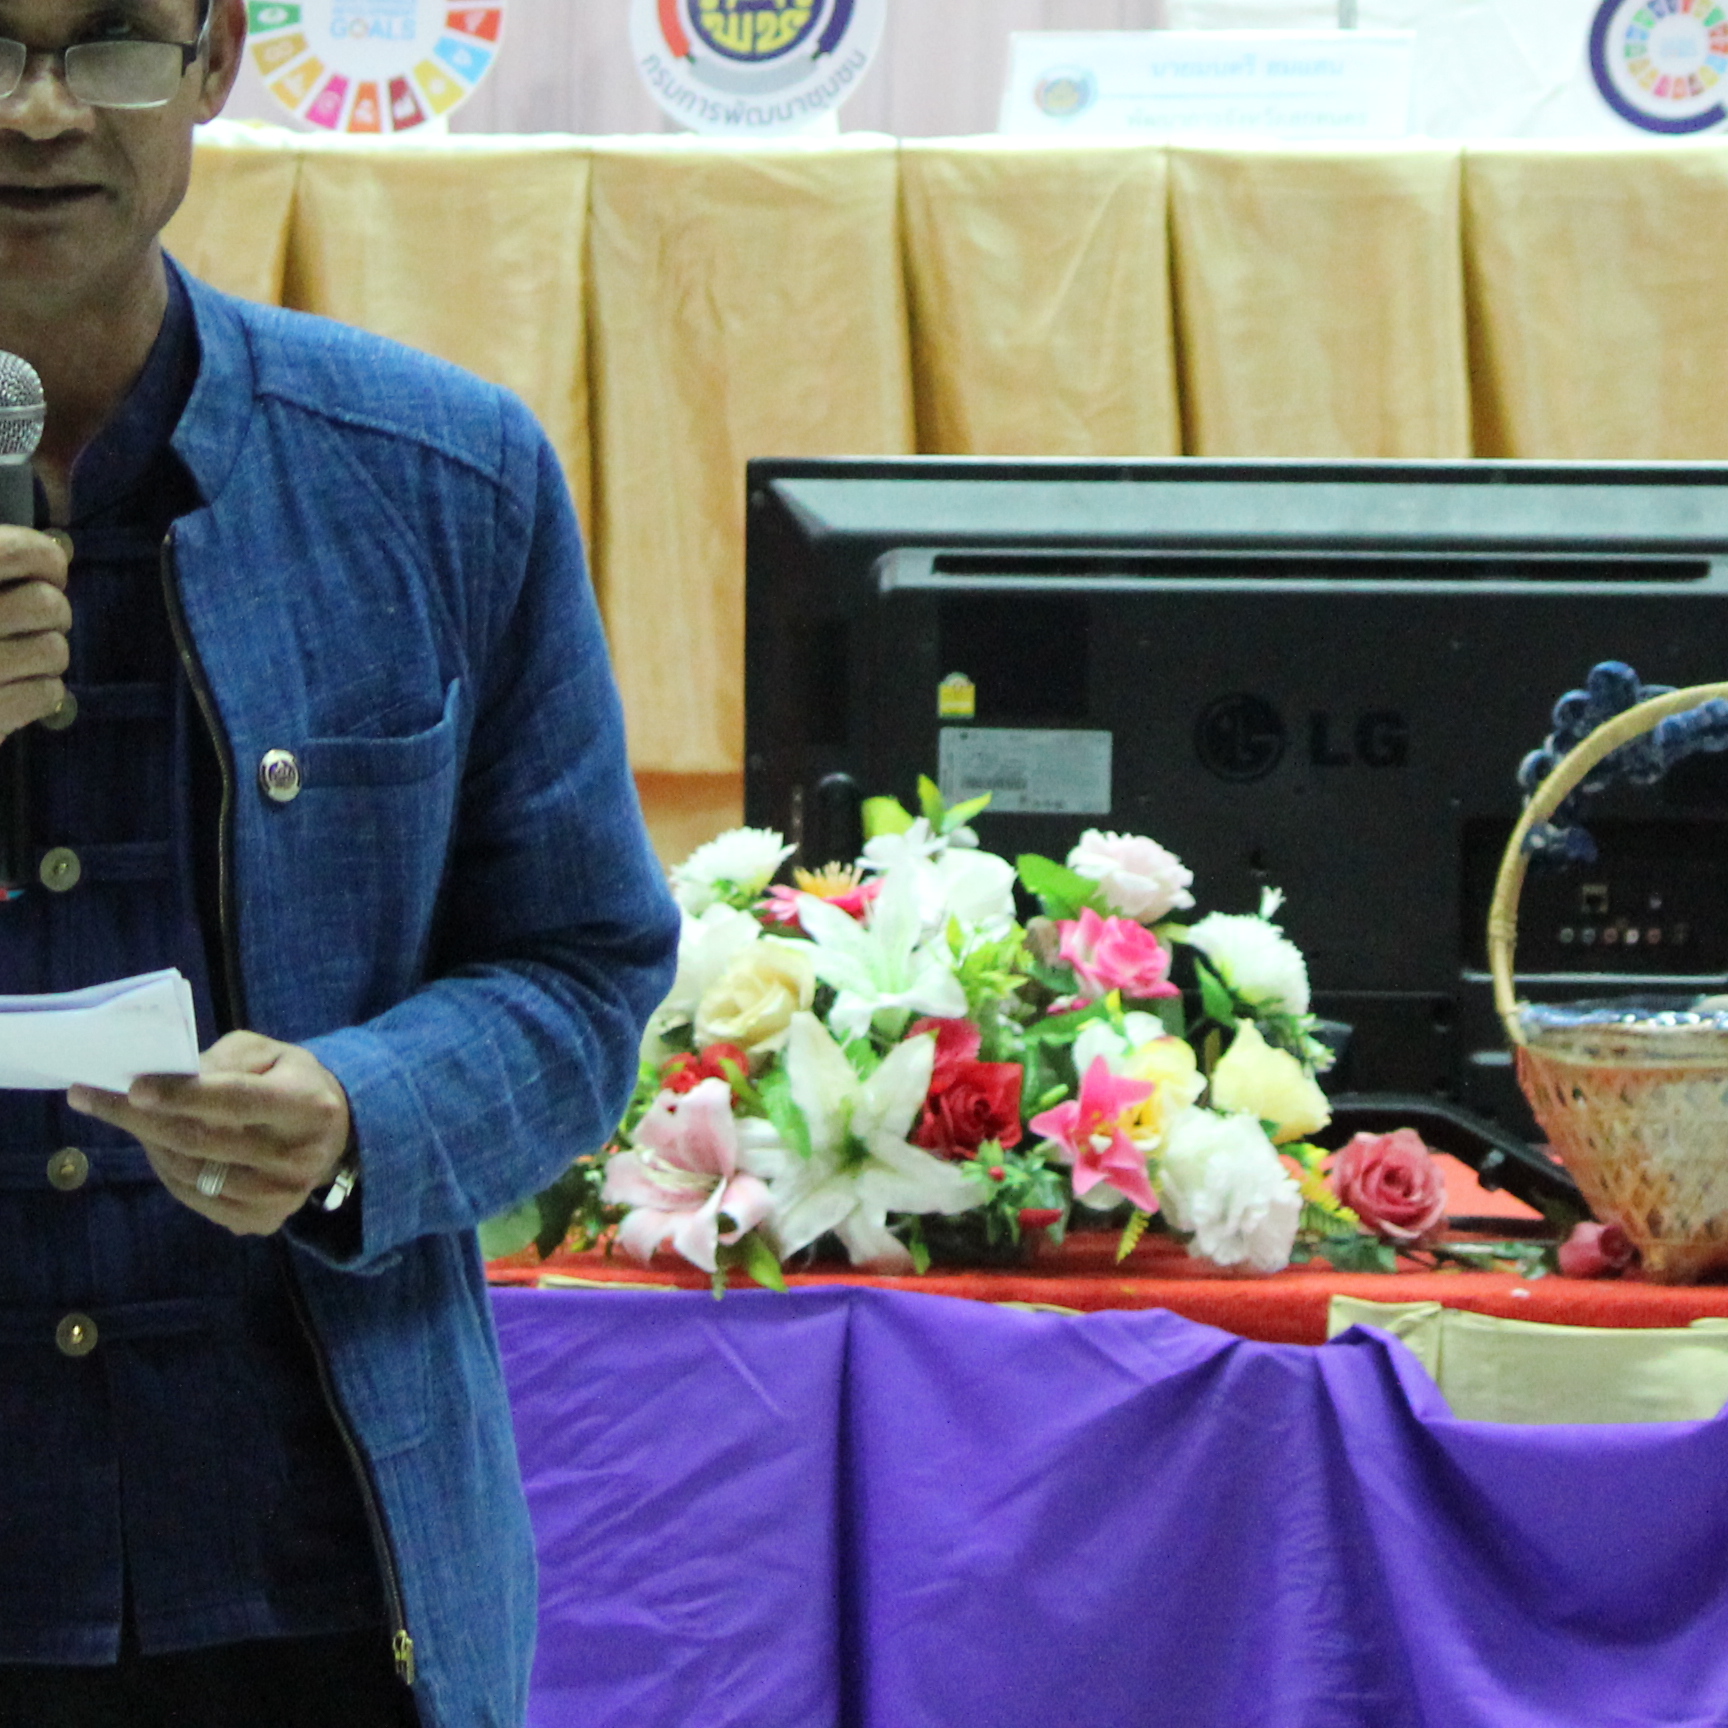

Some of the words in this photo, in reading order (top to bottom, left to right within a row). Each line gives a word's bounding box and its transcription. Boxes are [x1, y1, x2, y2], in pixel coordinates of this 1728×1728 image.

[642, 50, 867, 126] กรมการพัฒนาชุมชน
[1309, 709, 1412, 768] LG
